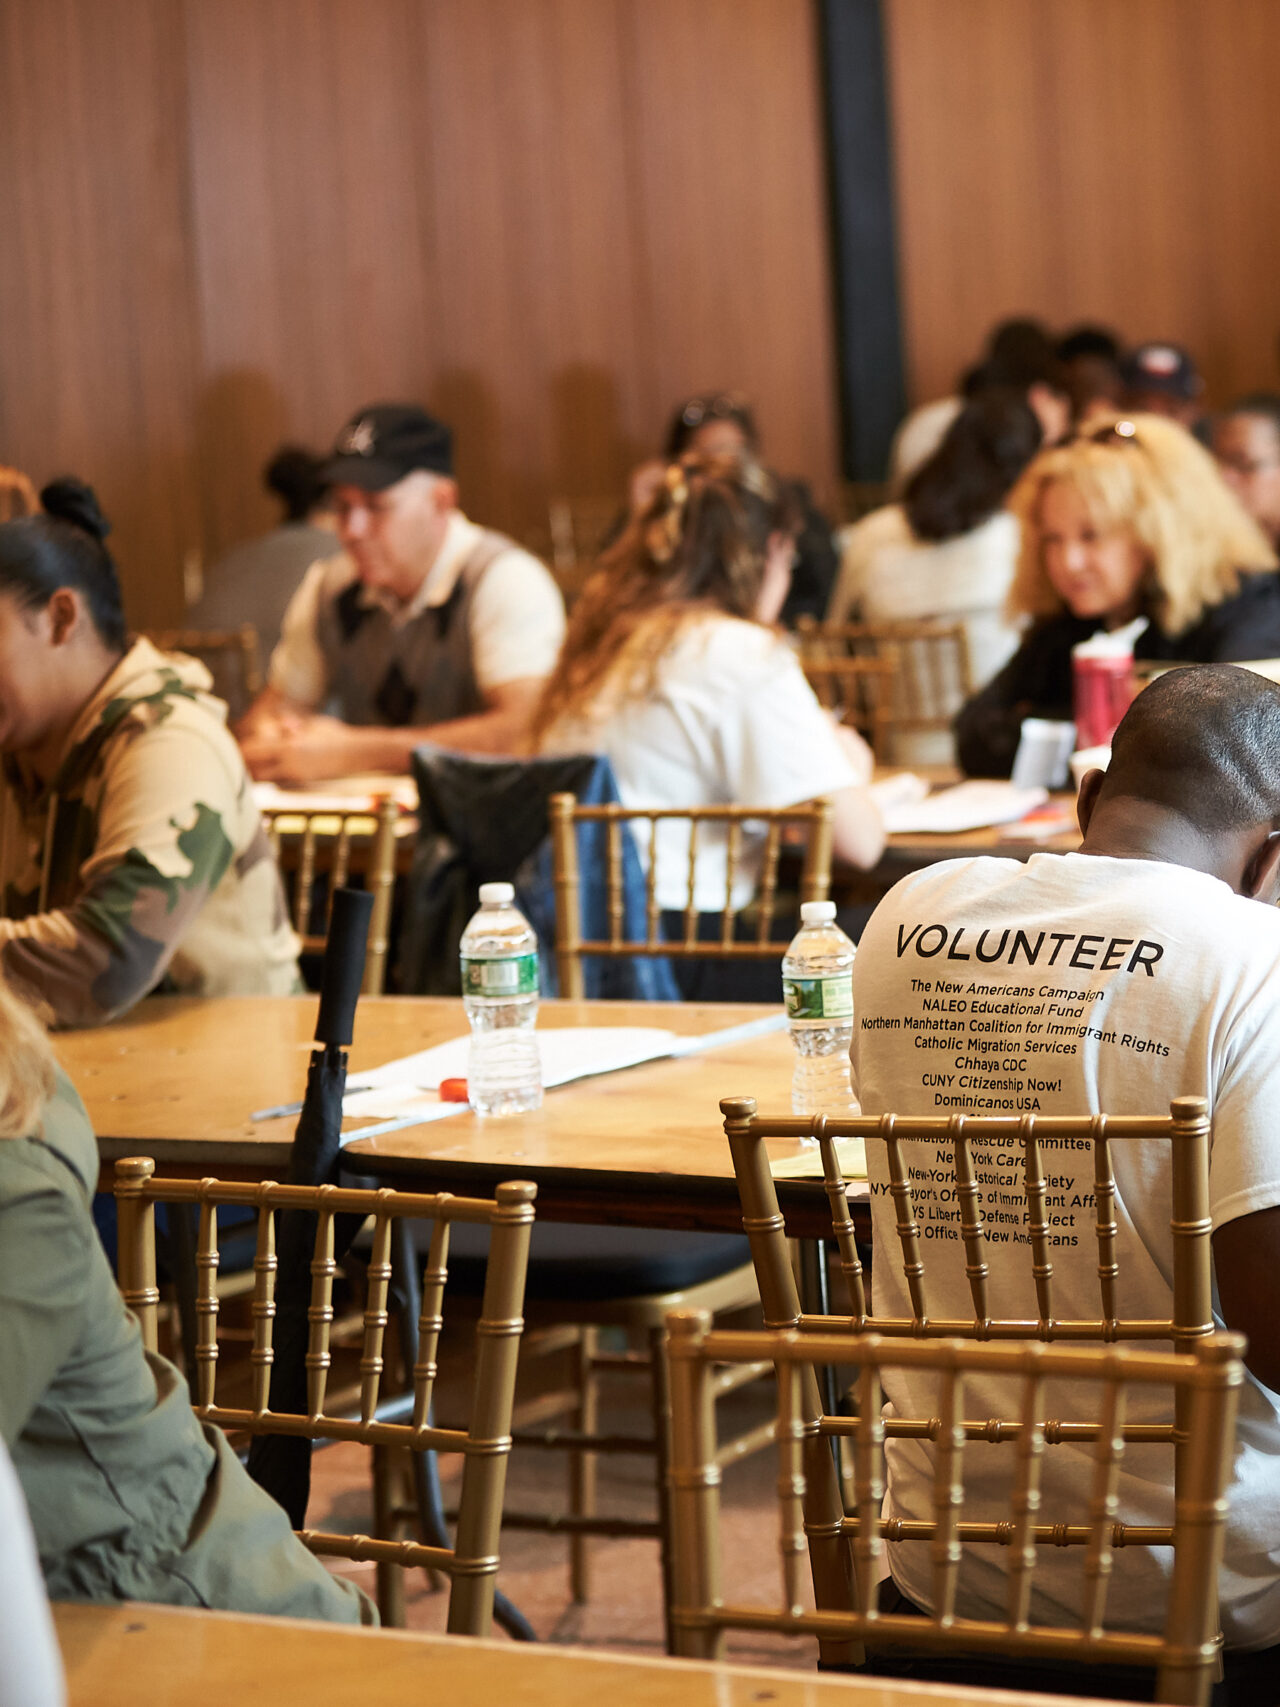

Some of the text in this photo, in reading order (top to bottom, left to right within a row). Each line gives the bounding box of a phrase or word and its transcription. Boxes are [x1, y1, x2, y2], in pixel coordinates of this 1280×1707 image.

[896, 924, 1164, 977] VOLUNTEER
[911, 979, 1104, 1002] The New Americans Campaign
[922, 999, 1084, 1018] NALEO Educational Fund
[861, 1017, 1170, 1057] Northern Manhattan Coalition for Immigrant Rights
[914, 1036, 1077, 1054] Catholic Migration Services
[955, 1057, 1027, 1072] Chhaya CDC
[922, 1074, 1062, 1092] CUNY Citizenship Now!
[935, 1093, 1041, 1111] Dominicanos USA
[936, 1150, 1027, 1168] Ne York Care
[908, 1166, 957, 1182] New-York
[975, 1171, 1018, 1186] istorical
[910, 1188, 937, 1202] ayor's
[987, 1191, 997, 1203] of
[1000, 1192, 1065, 1207] Immiant
[912, 1206, 924, 1219] YS
[929, 1207, 961, 1222] Libert
[978, 1209, 1019, 1225] Defense
[924, 1226, 958, 1240] Office
